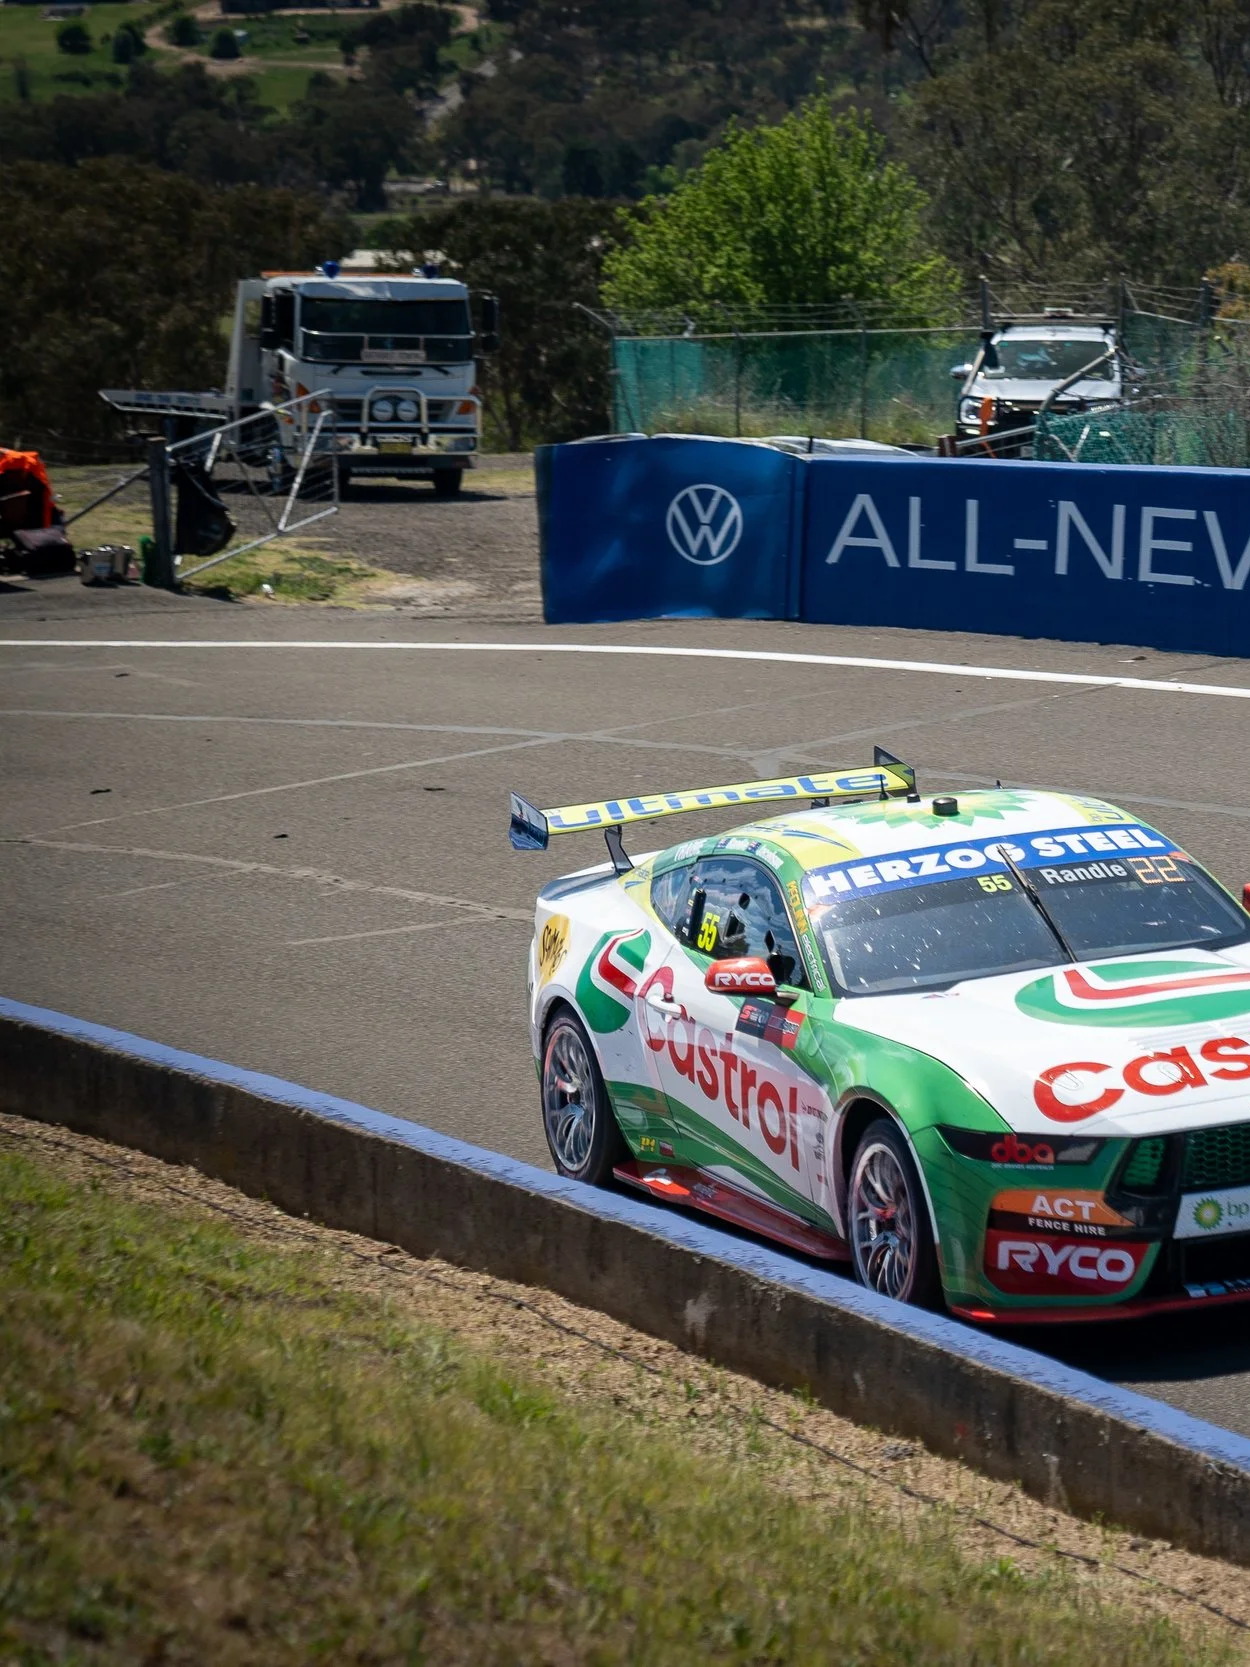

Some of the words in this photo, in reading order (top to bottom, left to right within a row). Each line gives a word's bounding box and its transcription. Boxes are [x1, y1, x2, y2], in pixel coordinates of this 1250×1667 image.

[548, 773, 889, 829] ultimate
[810, 843, 1027, 897] HERZOG
[1029, 828, 1166, 858] STEEL
[1040, 860, 1128, 885] Randle
[1127, 855, 1186, 885] 22
[976, 875, 1013, 893] 55
[697, 912, 720, 952] 55
[715, 972, 776, 986] RYCO
[991, 1134, 1055, 1163] dba
[1031, 1194, 1096, 1220] ACT
[1227, 1199, 1250, 1218] bp
[1028, 1216, 1071, 1232] FENCE
[1074, 1223, 1106, 1236] HIRE
[997, 1240, 1135, 1282] RYCO
